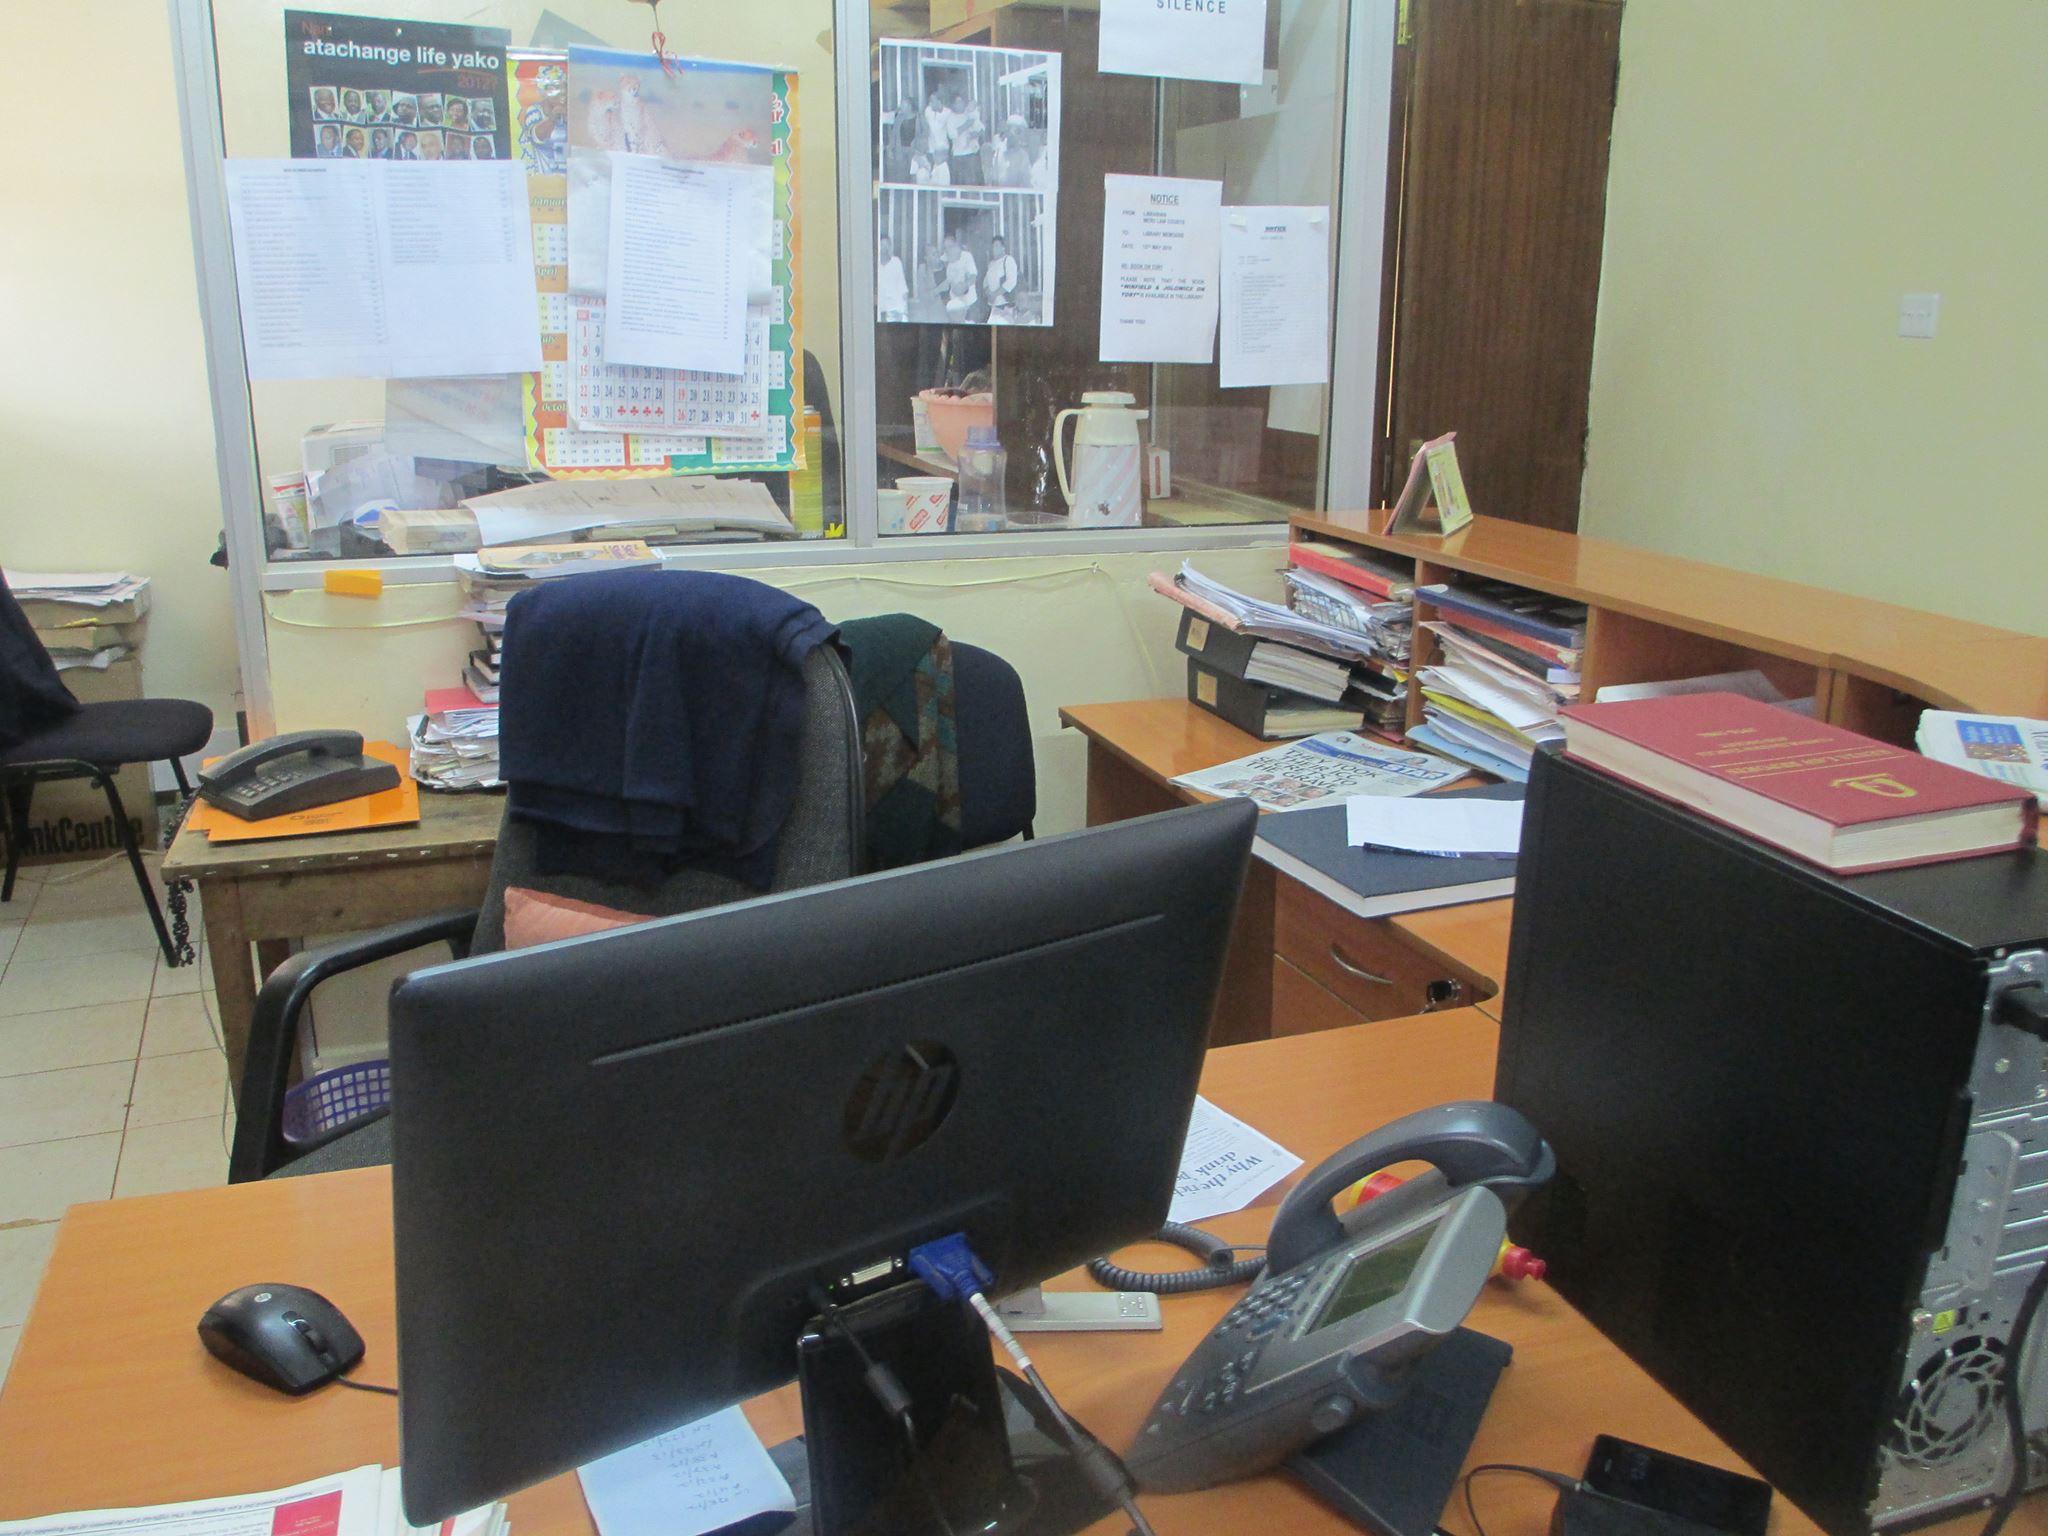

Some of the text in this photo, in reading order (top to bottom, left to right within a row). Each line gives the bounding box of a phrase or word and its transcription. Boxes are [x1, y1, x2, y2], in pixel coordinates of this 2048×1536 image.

[1156, 0, 1226, 14] SILENCE
[303, 39, 500, 70] atachange life yako
[1150, 193, 1180, 206] NOTICE
[595, 325, 602, 338] 2
[582, 344, 601, 357] 8 9
[753, 354, 760, 366] 11
[580, 365, 589, 378] 15
[592, 365, 601, 378] 16
[605, 366, 613, 378] 17
[751, 372, 760, 385] 18
[580, 384, 663, 400] 22 23 24 25 26 27 28
[703, 389, 710, 402] 21
[715, 390, 723, 403] 22
[728, 390, 736, 403] 23
[740, 391, 748, 404] 24
[751, 392, 759, 405] 25
[580, 405, 613, 419] 29 30 31
[677, 408, 748, 425] 26 27 28 29 30 31
[1281, 755, 1329, 772] THEIR
[1285, 747, 1332, 763] THEY
[1332, 763, 1384, 778] TOOK
[1246, 760, 1336, 789] THE GRAVE
[1259, 756, 1328, 780] SECRETS
[1331, 777, 1358, 786] TO
[1196, 1151, 1237, 1178] drink
[1227, 1155, 1263, 1176] Why
[1201, 1170, 1228, 1191] the
